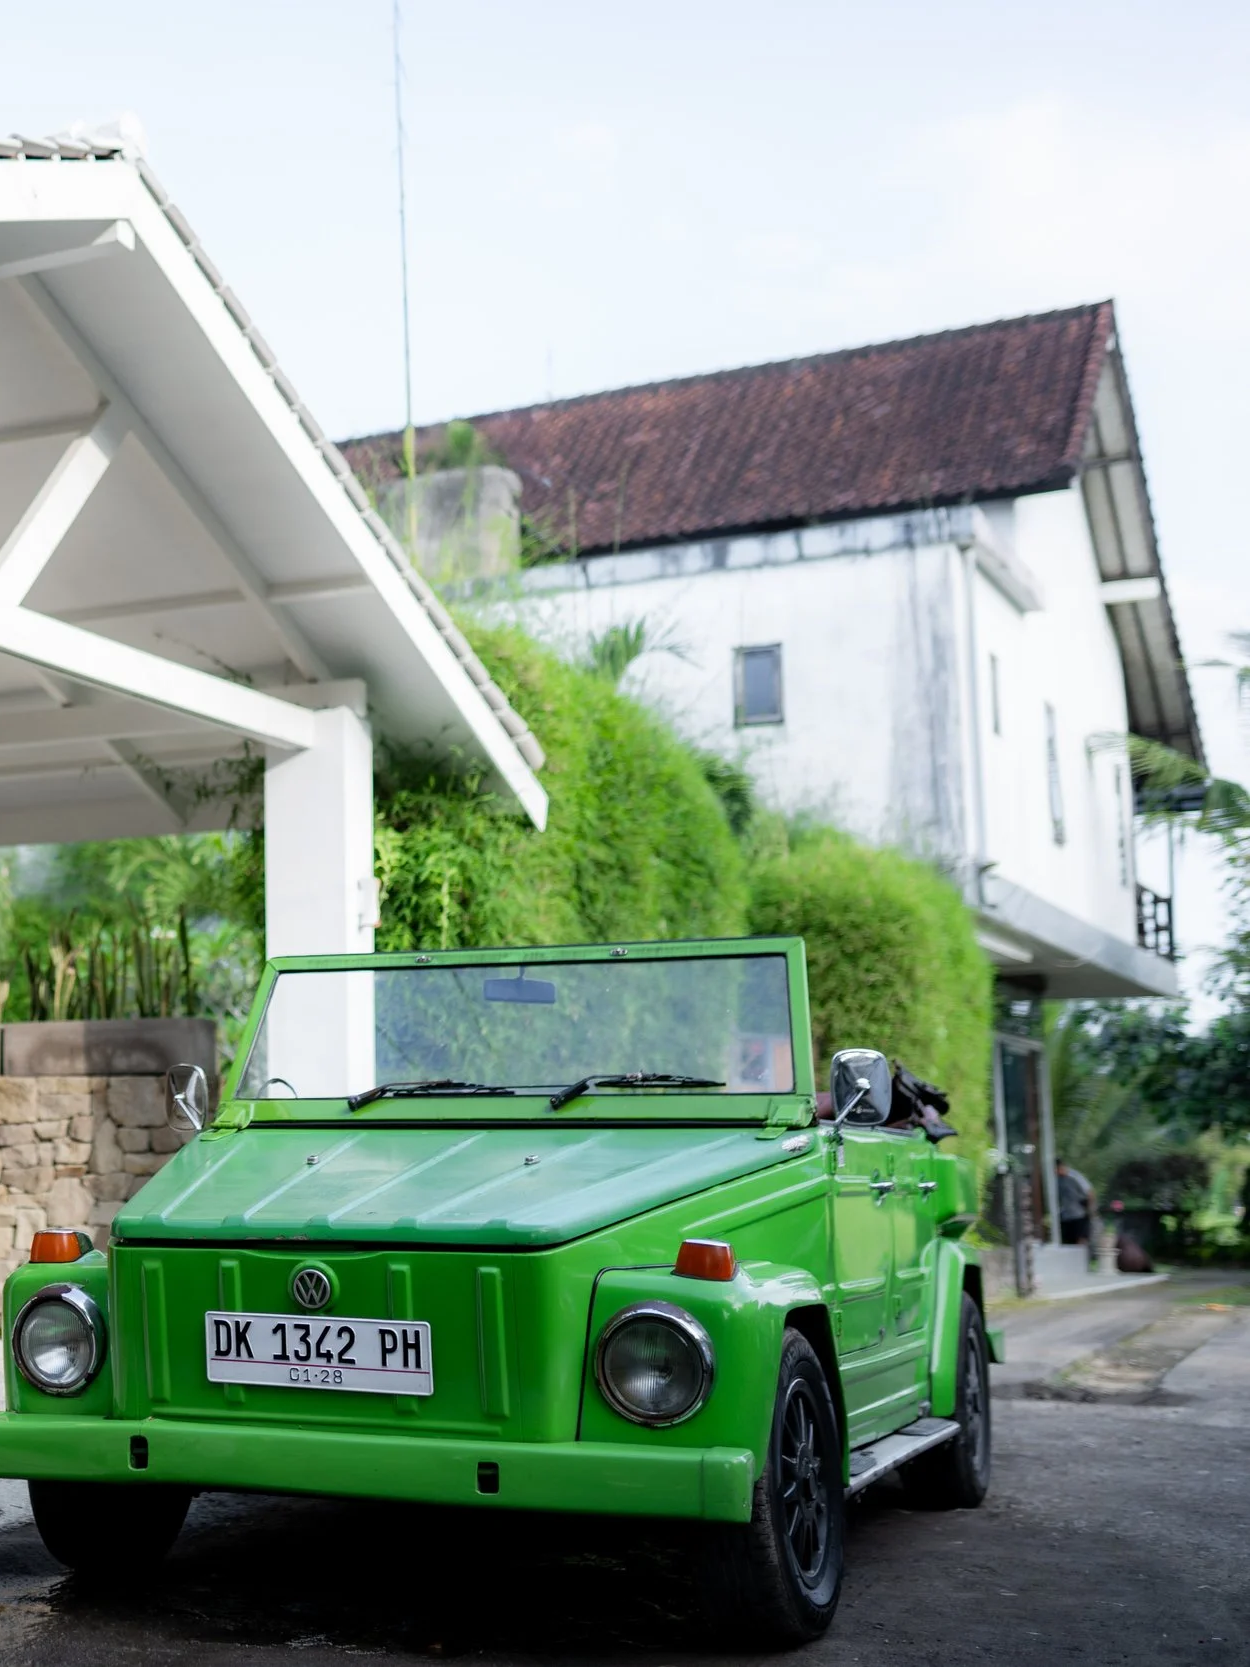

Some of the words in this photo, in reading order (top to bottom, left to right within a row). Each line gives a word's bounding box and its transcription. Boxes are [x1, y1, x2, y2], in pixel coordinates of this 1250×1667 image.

[294, 1269, 330, 1308] VW
[213, 1319, 254, 1359] DK
[271, 1323, 356, 1366] 1342
[378, 1328, 422, 1369] PH
